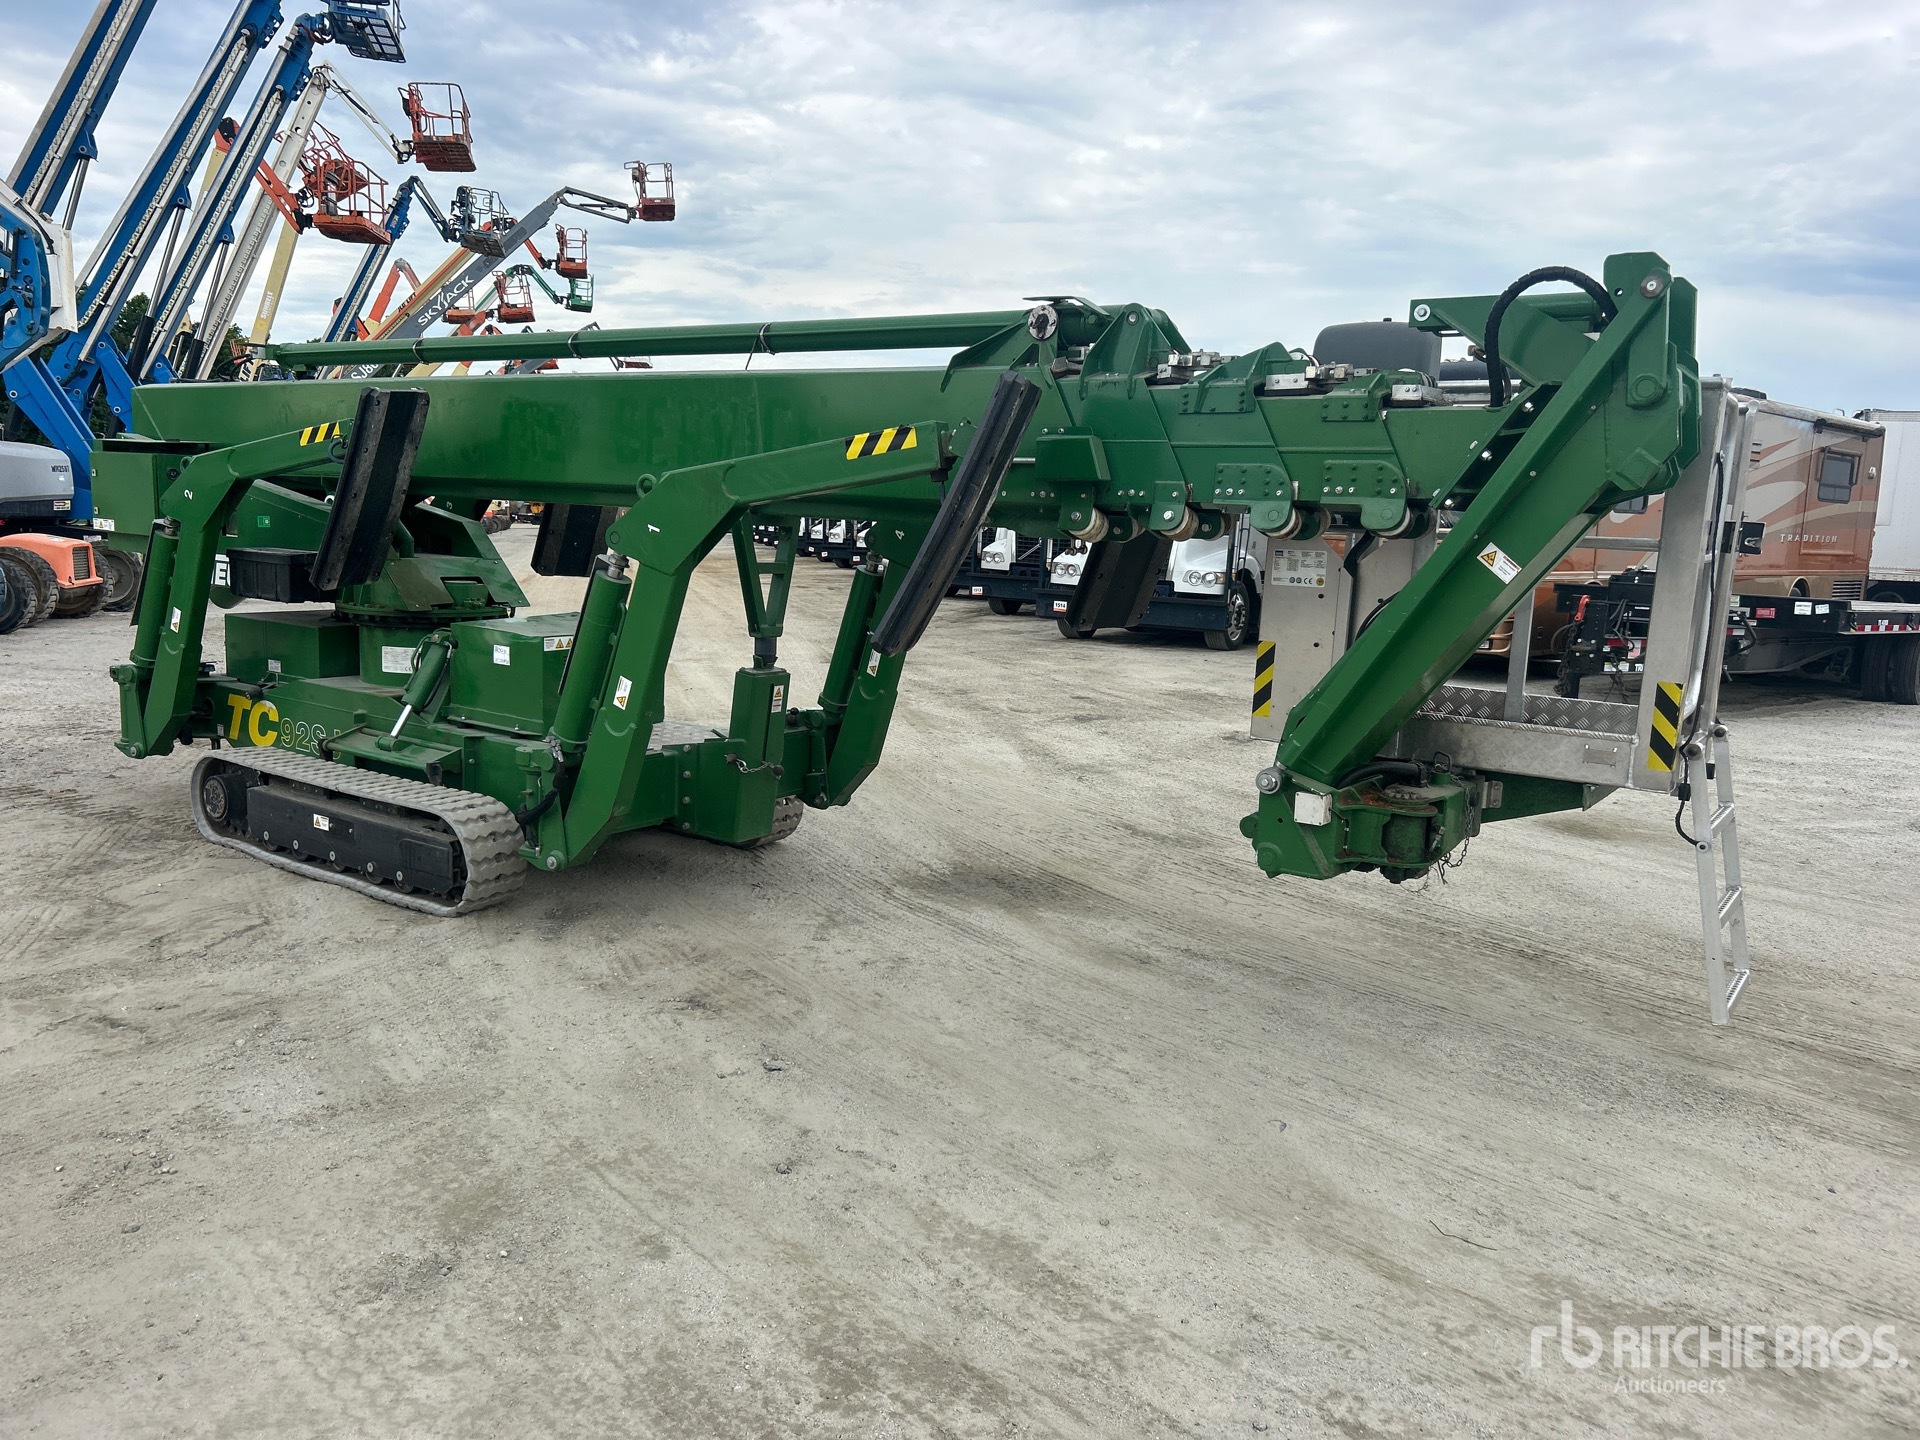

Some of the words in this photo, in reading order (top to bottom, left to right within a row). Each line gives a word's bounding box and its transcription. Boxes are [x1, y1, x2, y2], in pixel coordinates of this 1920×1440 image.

[418, 275, 475, 326] SKYJACK
[184, 489, 193, 500] 2
[446, 501, 453, 510] 3
[647, 523, 660, 533] 1
[895, 530, 905, 540] 4
[1780, 533, 1838, 543] TRADITION
[227, 693, 279, 747] TC
